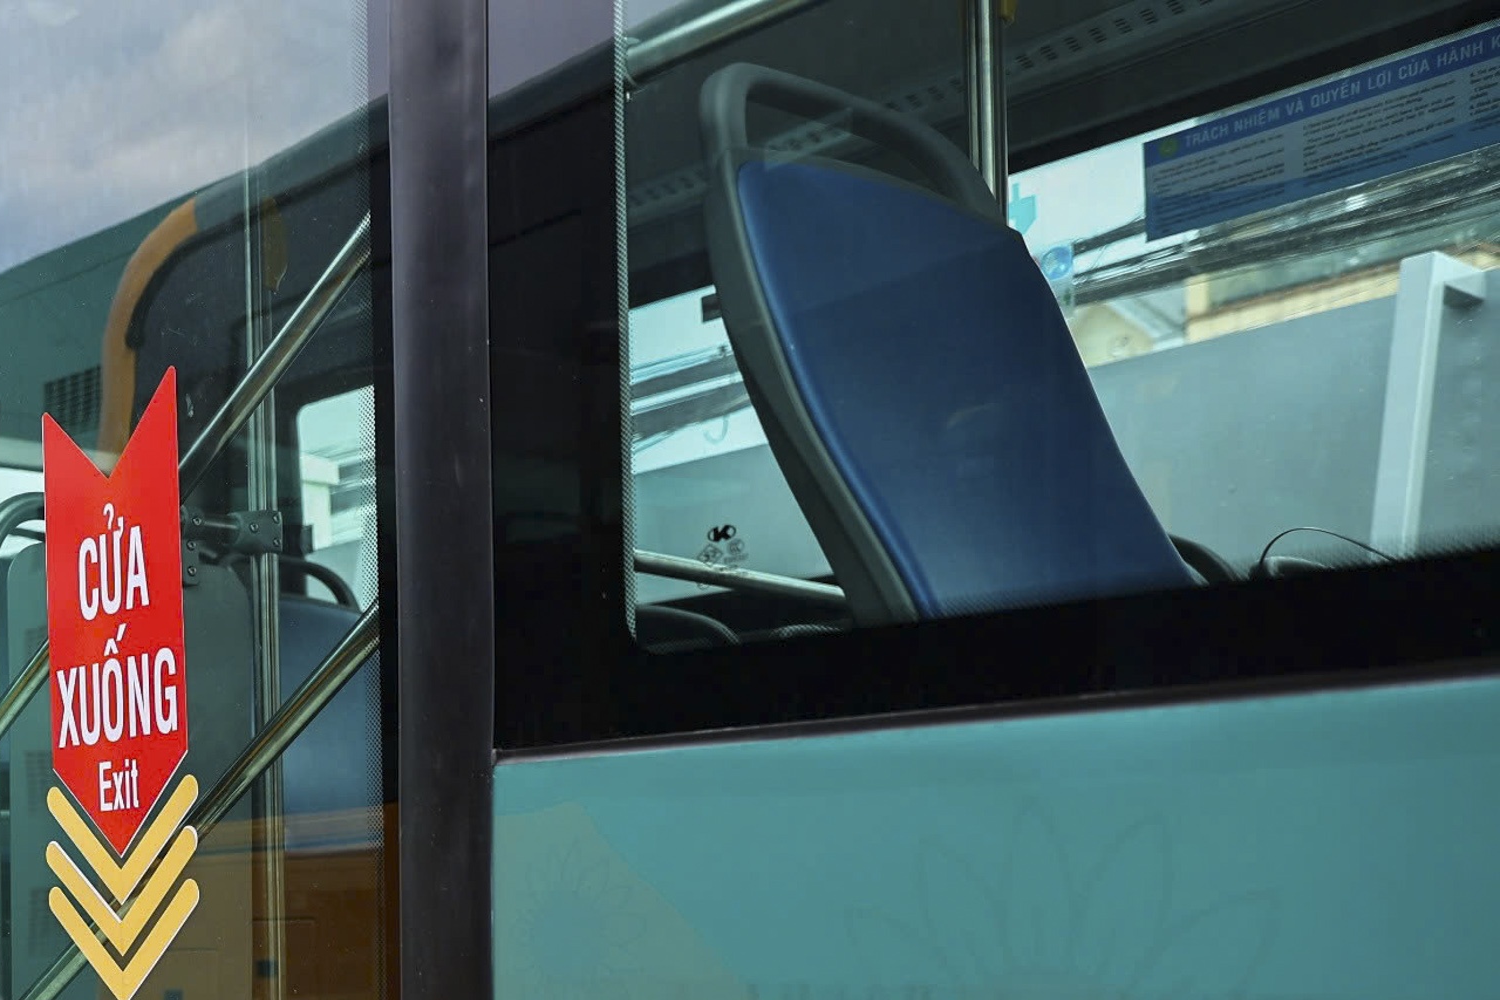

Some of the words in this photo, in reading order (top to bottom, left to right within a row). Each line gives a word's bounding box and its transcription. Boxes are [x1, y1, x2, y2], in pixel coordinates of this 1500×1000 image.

[1185, 124, 1229, 148] TRÁCH
[1234, 106, 1281, 132] NHIỆM
[1286, 98, 1304, 117] VÀ
[1398, 56, 1431, 80] CỦA
[1437, 40, 1484, 68] HÀNH
[78, 502, 150, 621] CỬA
[56, 623, 178, 749] XUỐNG
[99, 759, 140, 812] Exit
